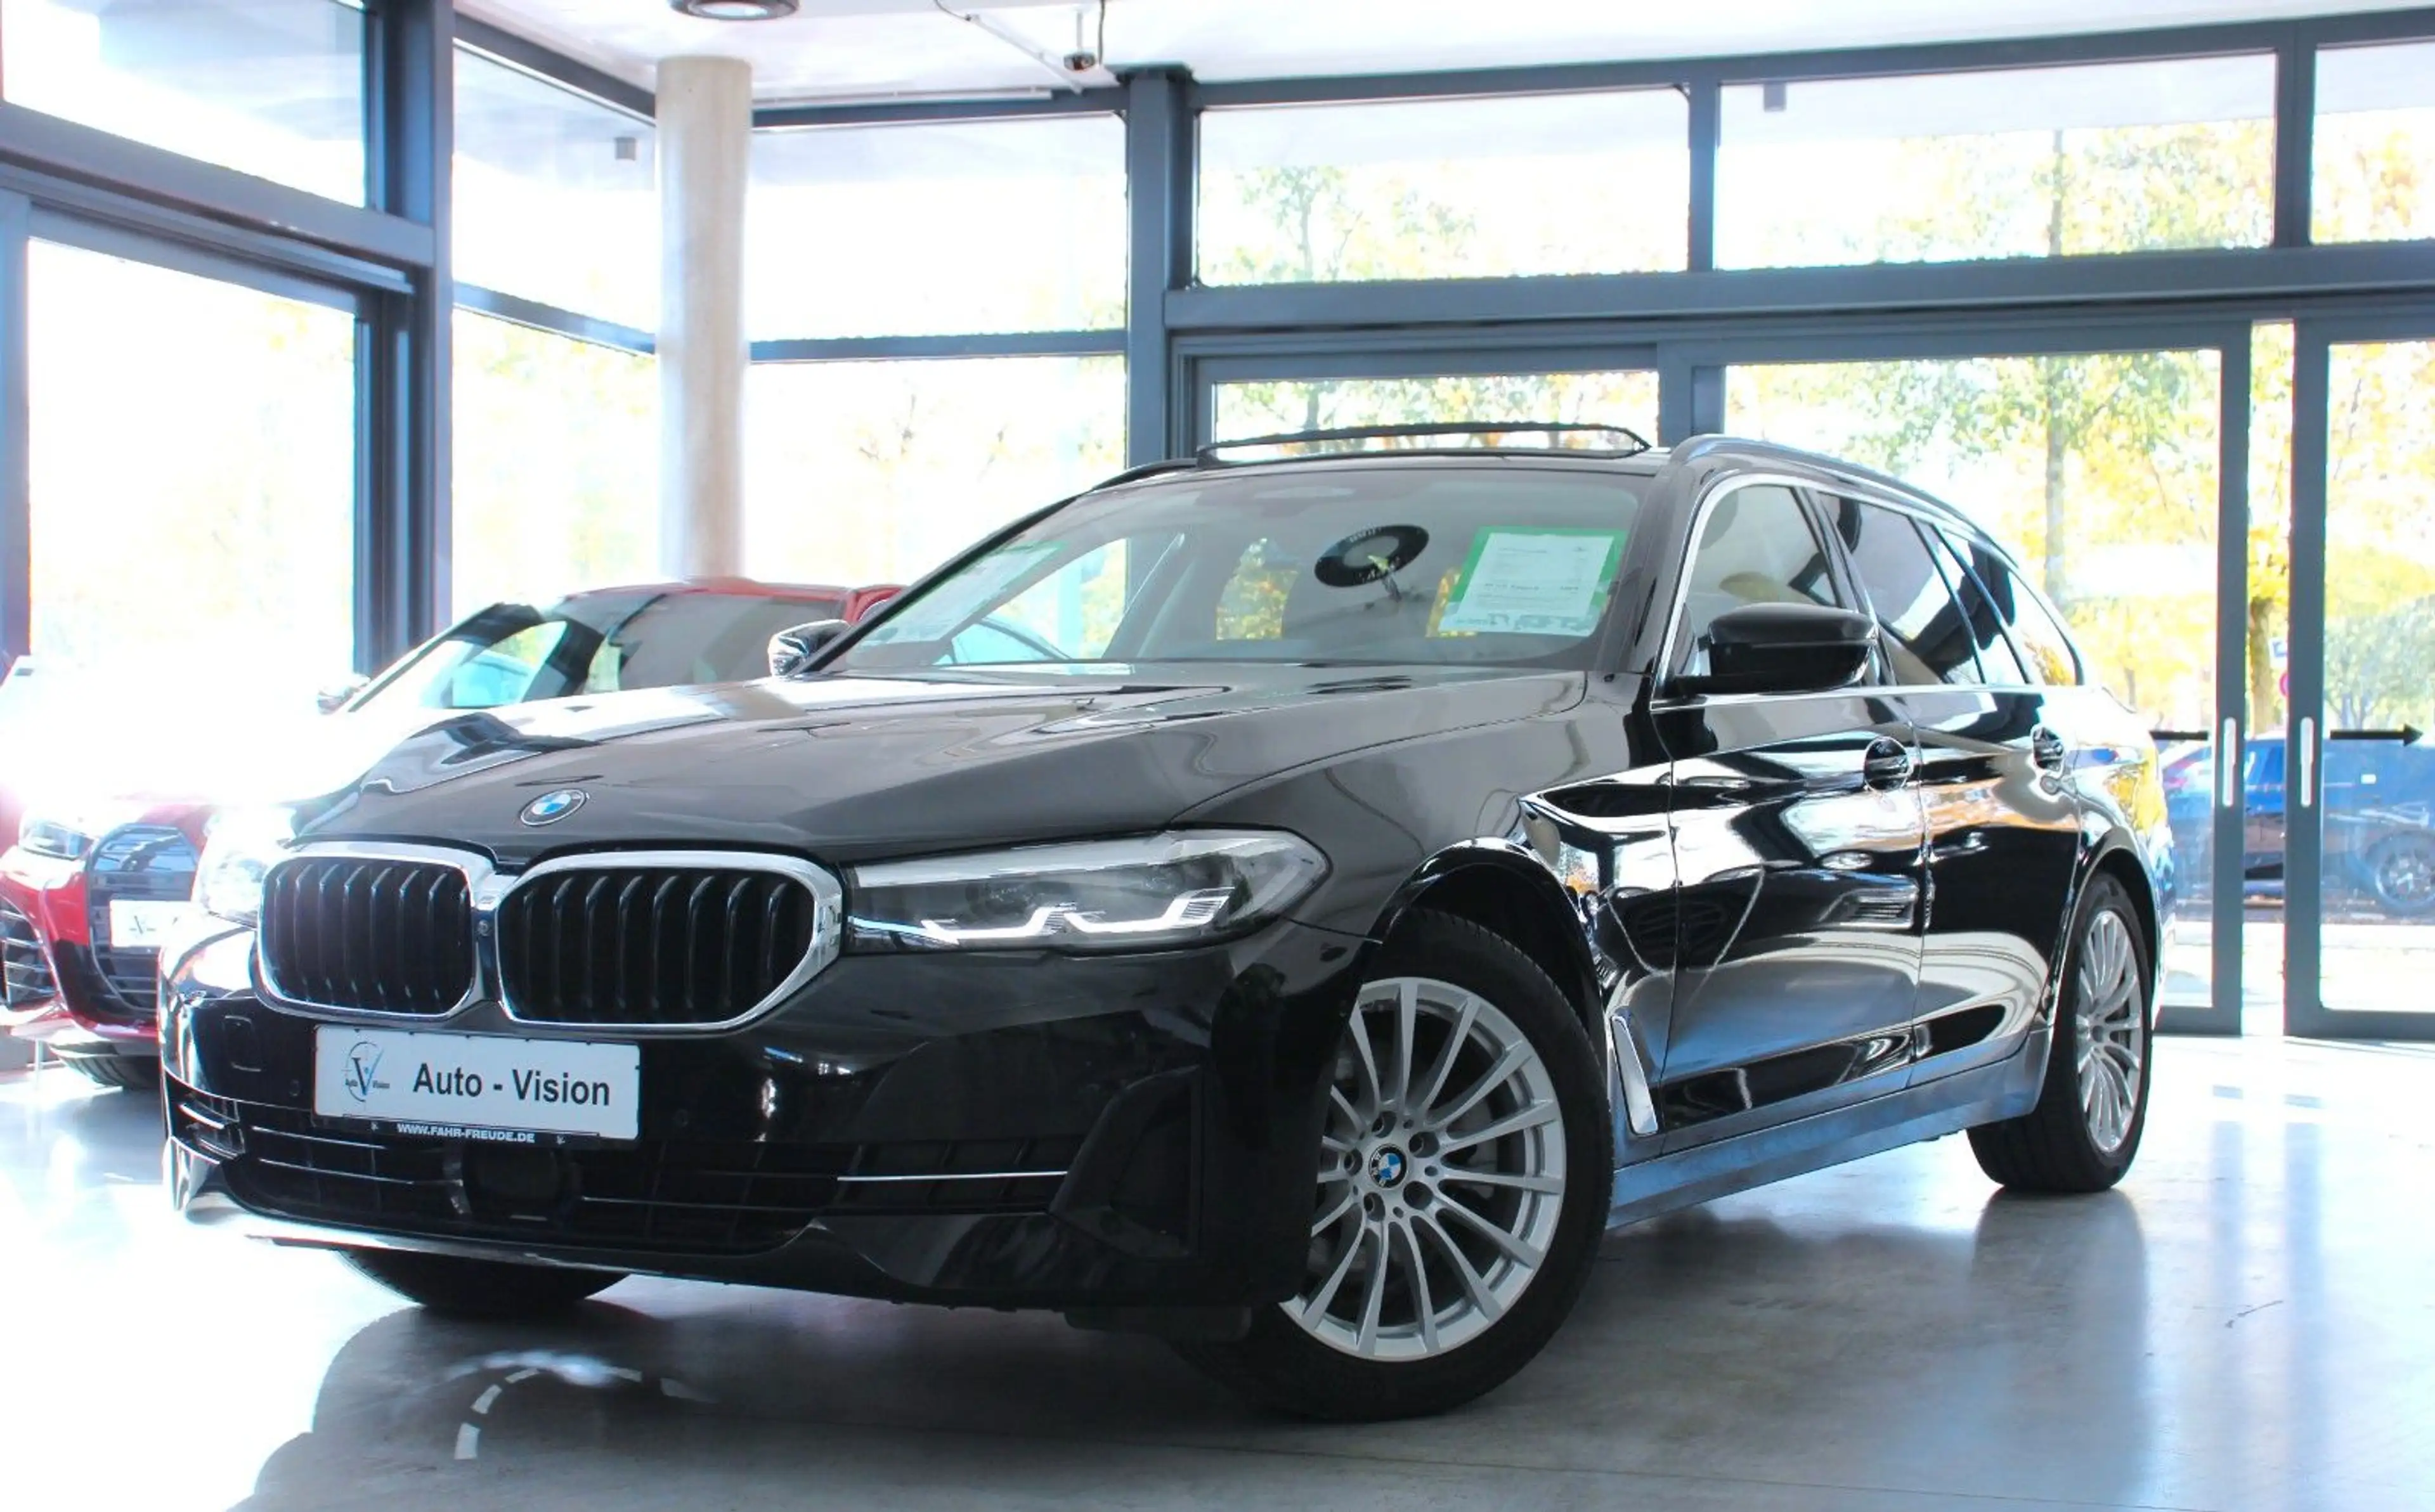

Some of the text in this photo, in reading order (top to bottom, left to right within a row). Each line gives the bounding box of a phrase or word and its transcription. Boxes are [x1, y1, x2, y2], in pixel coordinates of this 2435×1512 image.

[413, 1063, 482, 1097] Auto
[512, 1069, 610, 1106] Vision
[397, 1123, 535, 1144] WWW.FAHR-FREUDE.DE
